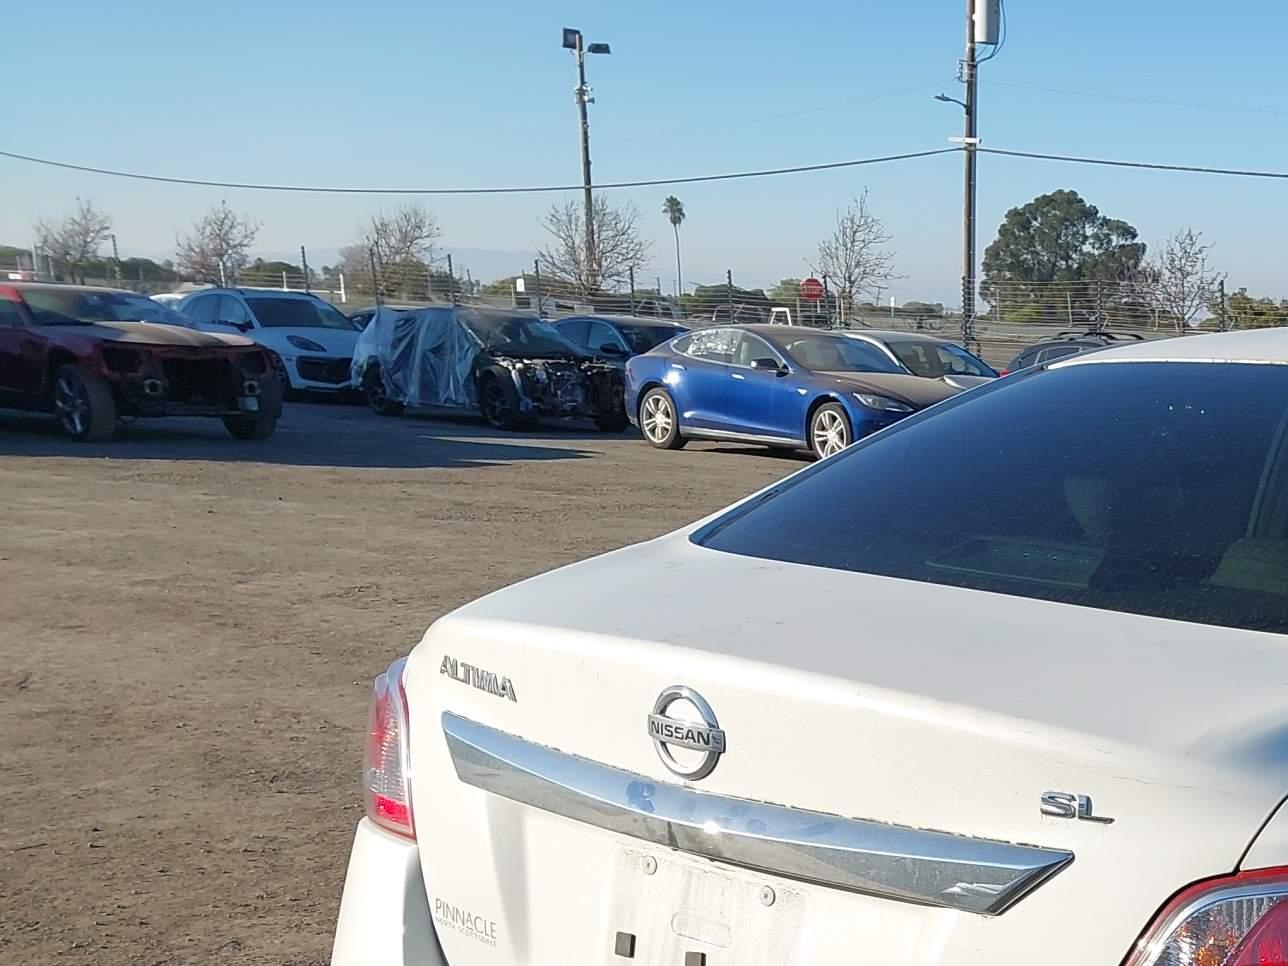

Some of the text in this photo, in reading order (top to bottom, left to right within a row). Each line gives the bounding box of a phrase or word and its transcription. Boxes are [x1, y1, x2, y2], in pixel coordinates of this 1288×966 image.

[439, 655, 517, 703] ALTIMA
[651, 720, 710, 745] NISSAN
[1040, 791, 1115, 824] SL
[435, 897, 497, 940] PINNACLE
